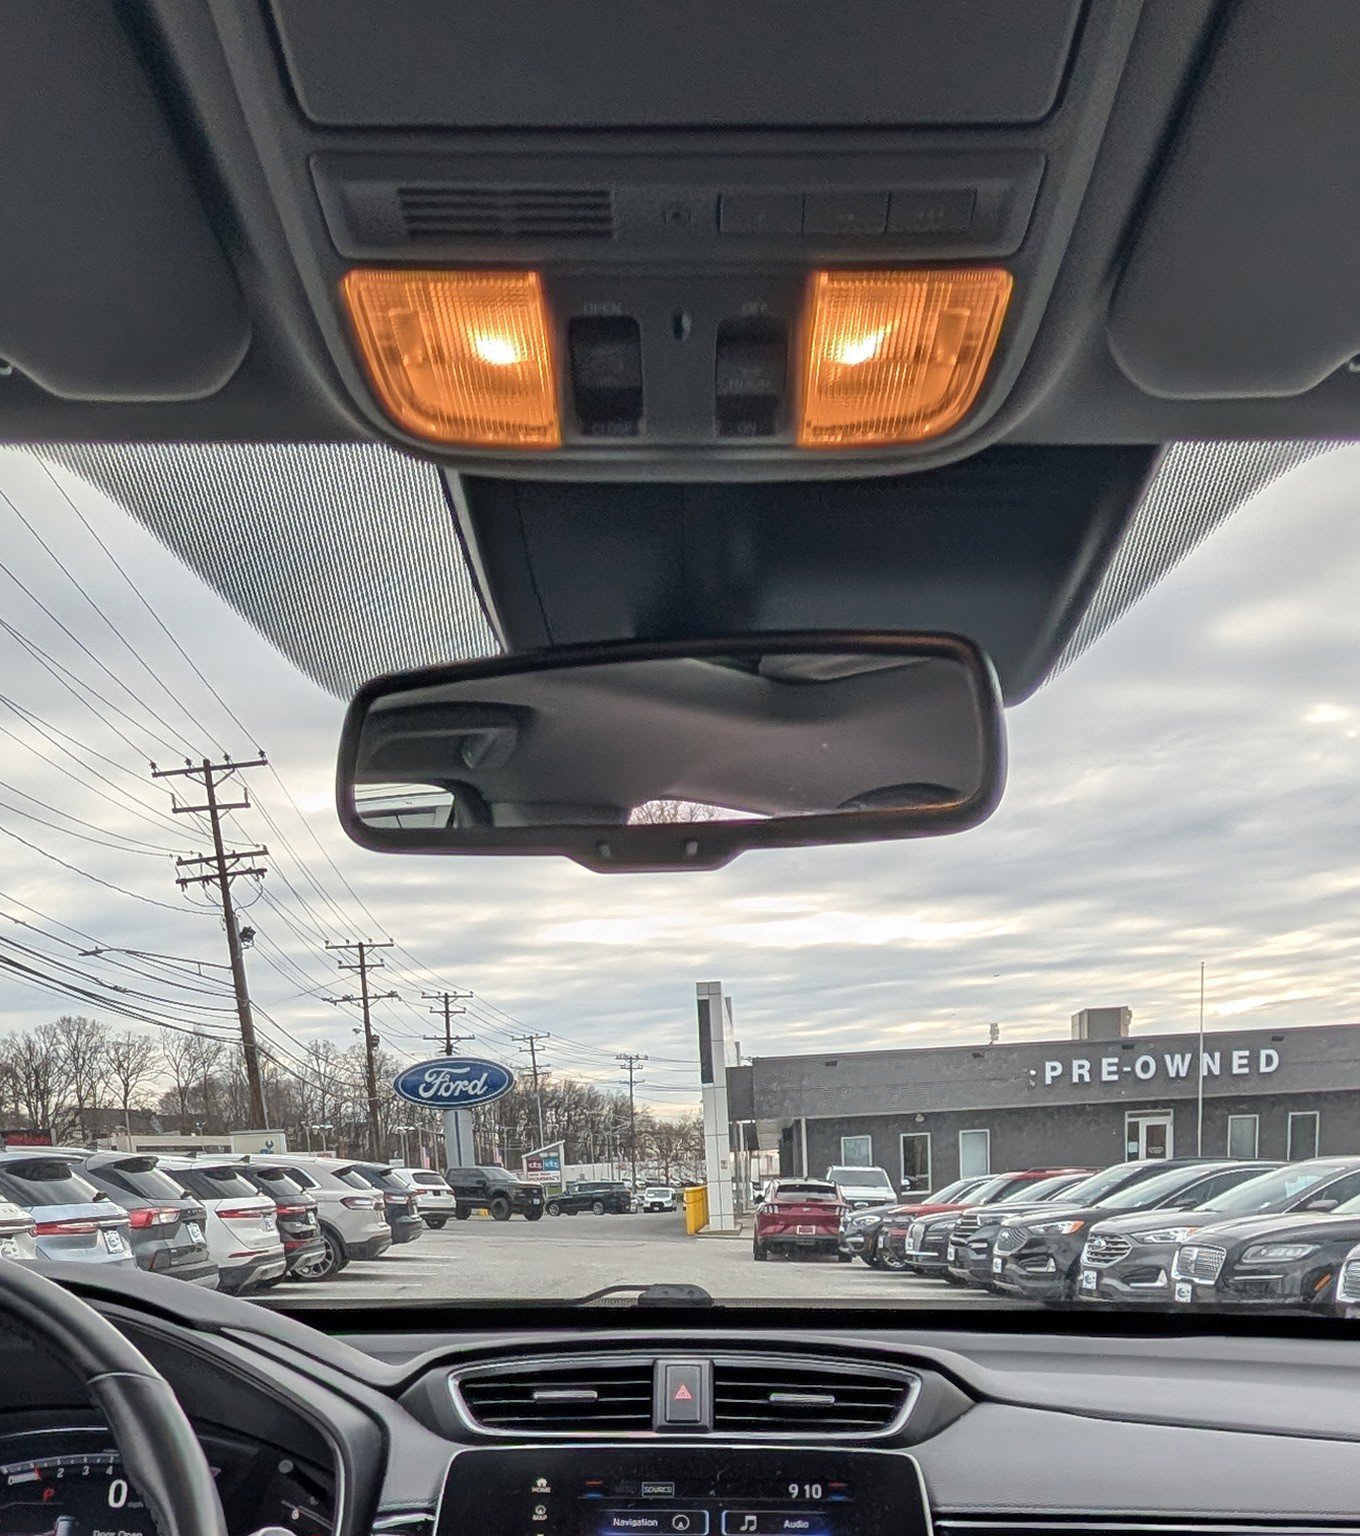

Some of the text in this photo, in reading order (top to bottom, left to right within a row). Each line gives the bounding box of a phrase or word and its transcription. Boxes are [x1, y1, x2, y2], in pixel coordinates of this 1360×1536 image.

[418, 1065, 490, 1098] Ford
[1045, 1049, 1280, 1086] PRE-OWNED
[108, 1479, 128, 1508] 0
[613, 1517, 658, 1527] Navigation
[783, 1519, 809, 1529] Audio
